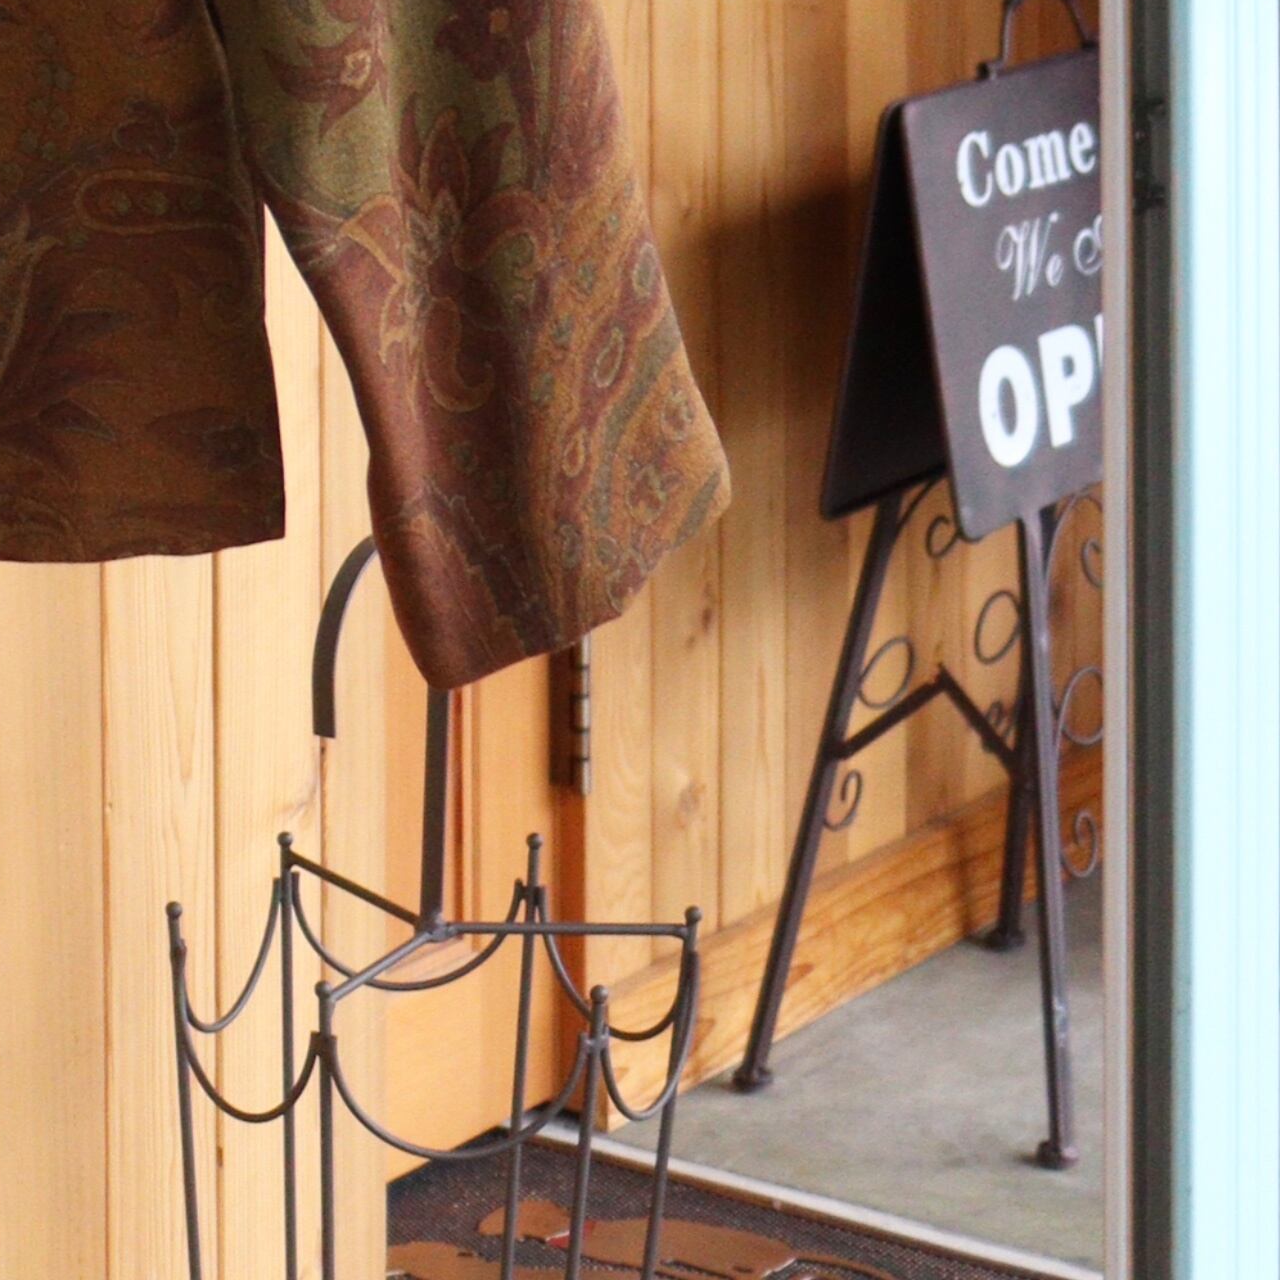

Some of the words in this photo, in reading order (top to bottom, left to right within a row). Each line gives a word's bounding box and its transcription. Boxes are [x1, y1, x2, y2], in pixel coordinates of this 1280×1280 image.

[956, 122, 1096, 208] Come
[996, 211, 1064, 301] We
[978, 314, 1104, 468] OP
